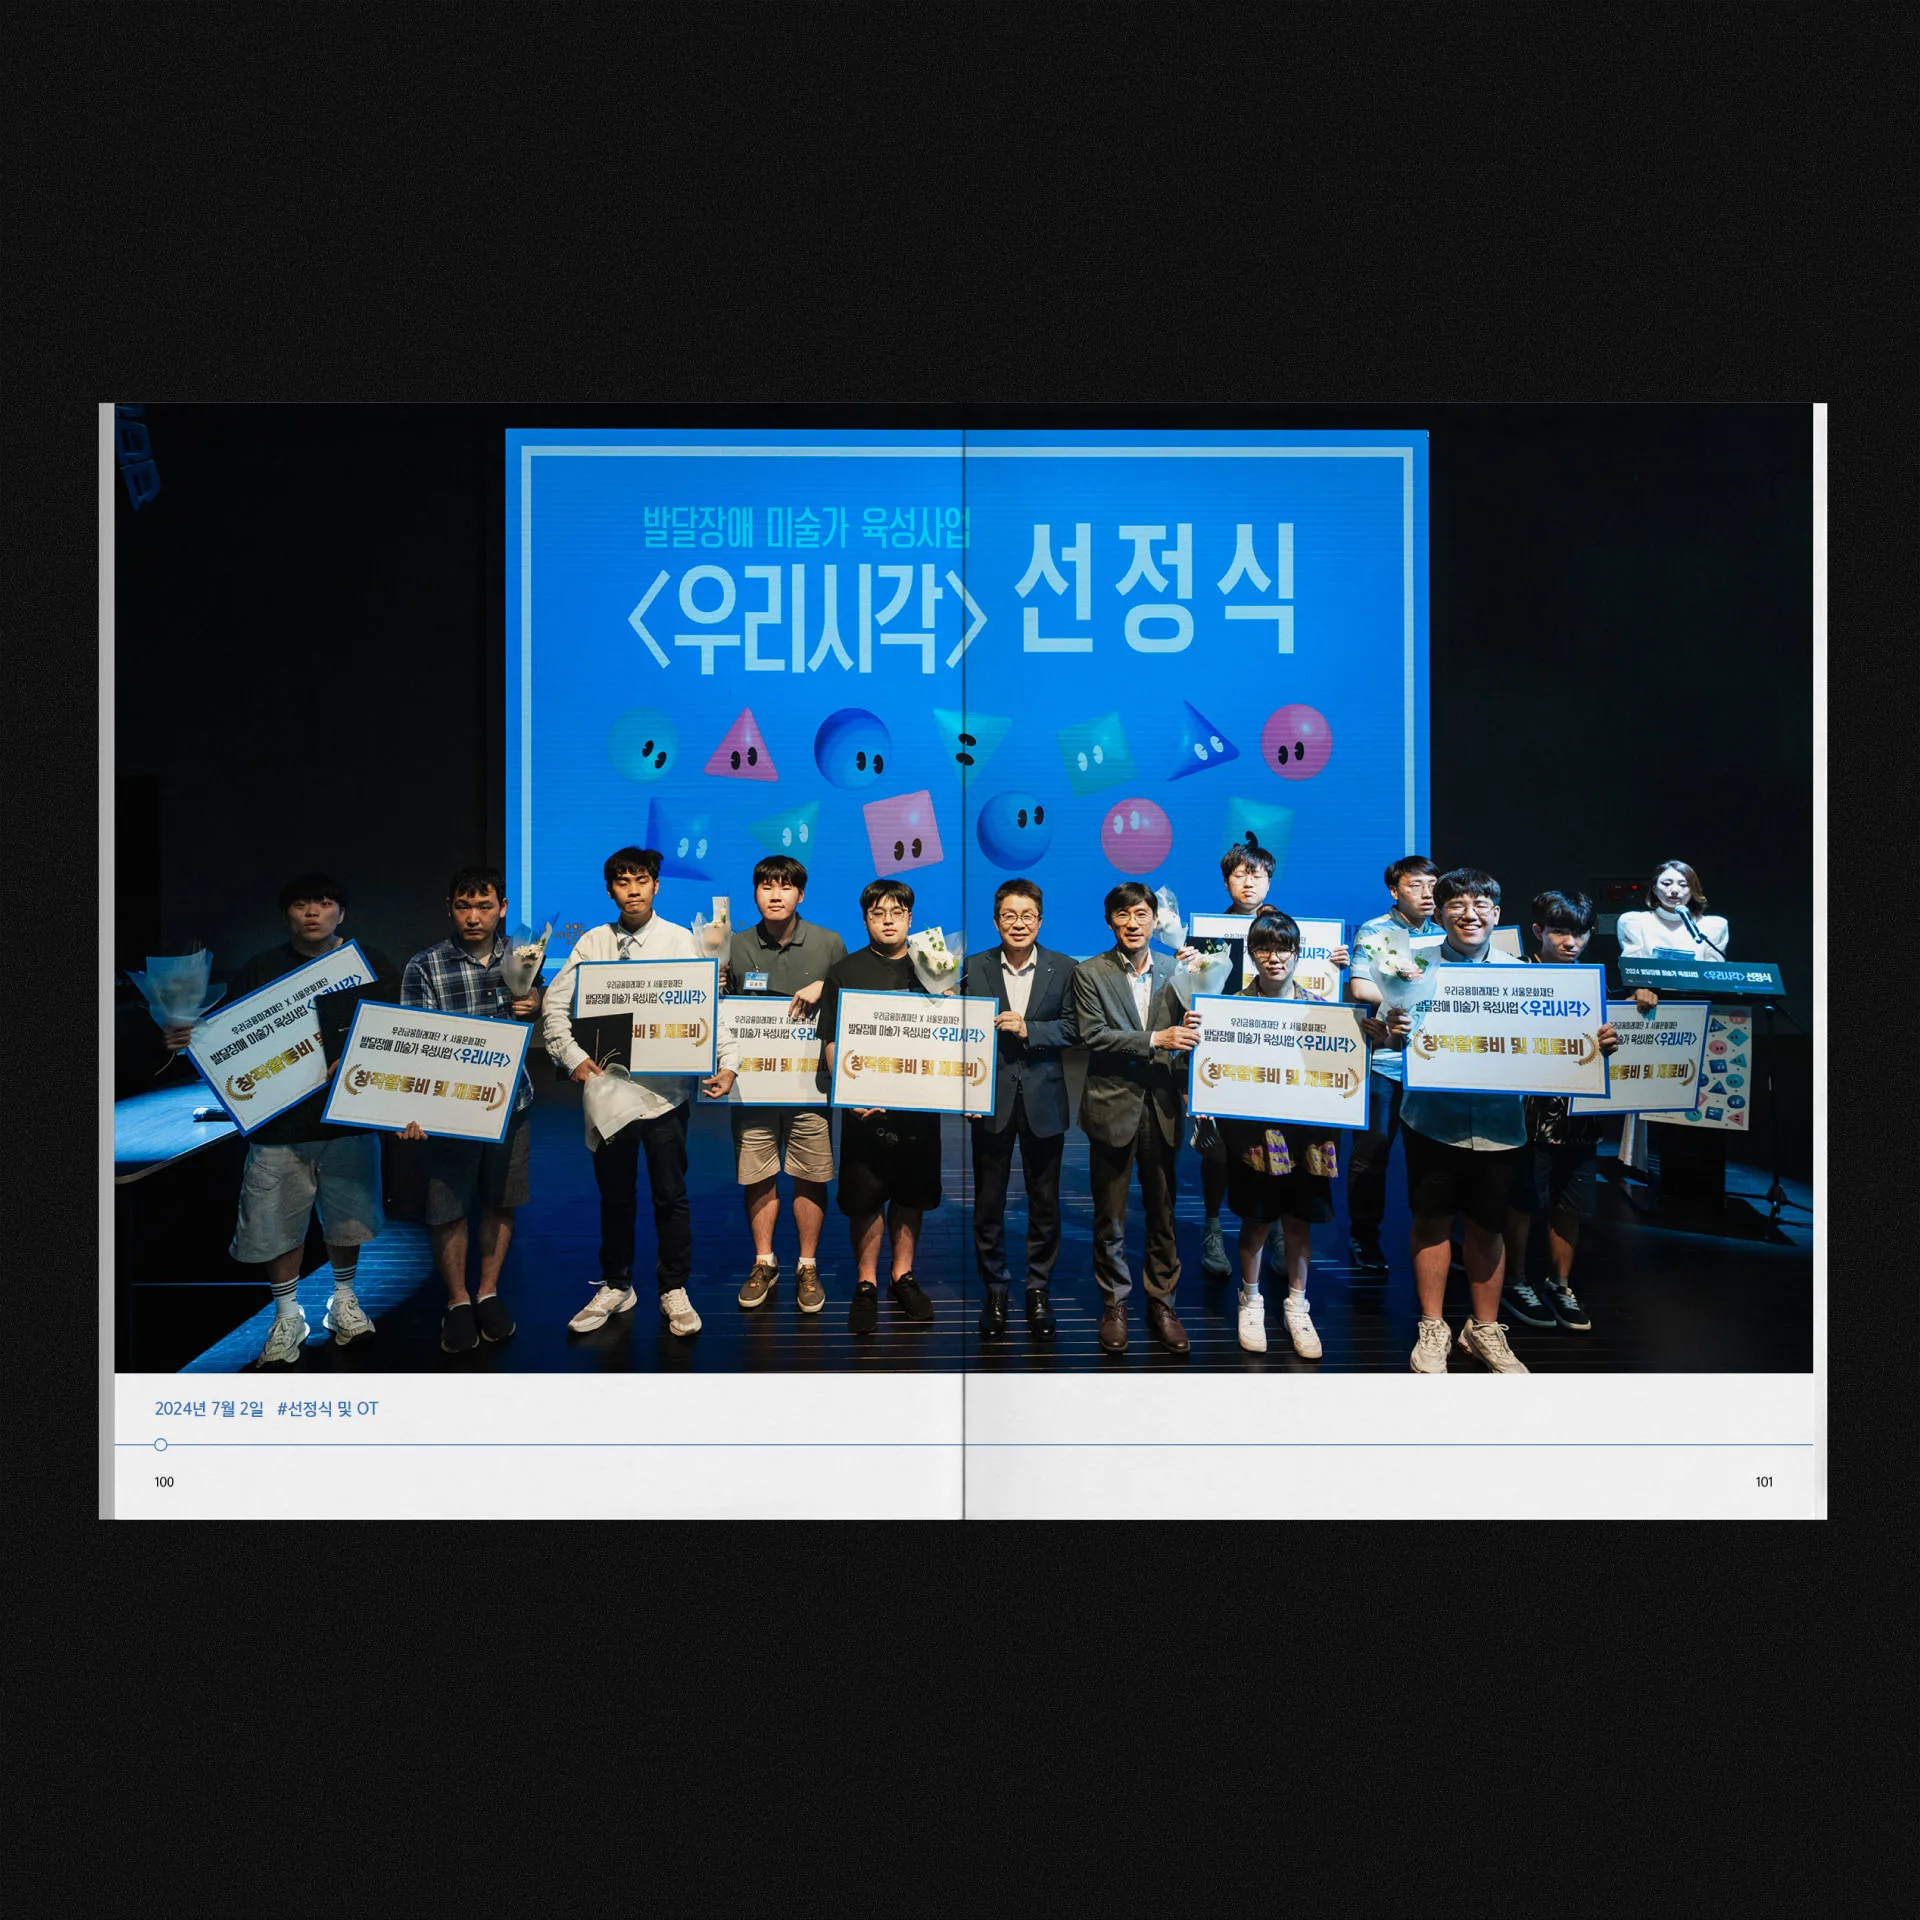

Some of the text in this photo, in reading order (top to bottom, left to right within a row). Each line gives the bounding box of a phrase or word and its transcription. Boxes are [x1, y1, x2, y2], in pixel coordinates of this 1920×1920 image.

[643, 506, 971, 549] 발달장애 미술가 육성사업
[1014, 522, 1294, 654] 선정식
[1299, 947, 1332, 959] 리시각>
[1625, 967, 1640, 975] 2024
[1294, 976, 1325, 990] 료비
[1444, 986, 1500, 996] 우리금융미래재단
[1512, 987, 1555, 997] 서울문화재단
[1453, 1001, 1480, 1013] 미술가
[1482, 1001, 1519, 1014] 육성사업
[210, 1038, 248, 1066] 발달장애
[246, 1025, 275, 1045] 미술가
[274, 1004, 309, 1029] 육성사업
[879, 1025, 900, 1037] 미술가
[1204, 1029, 1235, 1043] 발달장애
[1237, 1032, 1261, 1045] 미술가
[1263, 1033, 1294, 1048] 육성사업
[360, 1035, 393, 1052] 발달장애
[394, 1042, 419, 1054] 미술가
[420, 1044, 453, 1059] 육성사업
[1422, 1034, 1584, 1056] 창작활동비 및 재료비
[1617, 1034, 1629, 1045] 술가
[235, 1038, 315, 1092] 창작활동비
[921, 1060, 935, 1075] 및
[1610, 1064, 1641, 1080] 활동비
[1208, 1063, 1349, 1089] 창작활동비 및 재료비
[354, 1069, 497, 1103] 창작활동비 및 재료비
[155, 1401, 379, 1418] 2024년 7월 2일 #선정식 및 OT
[154, 1476, 174, 1488] 100
[1756, 1476, 1773, 1488] 101
